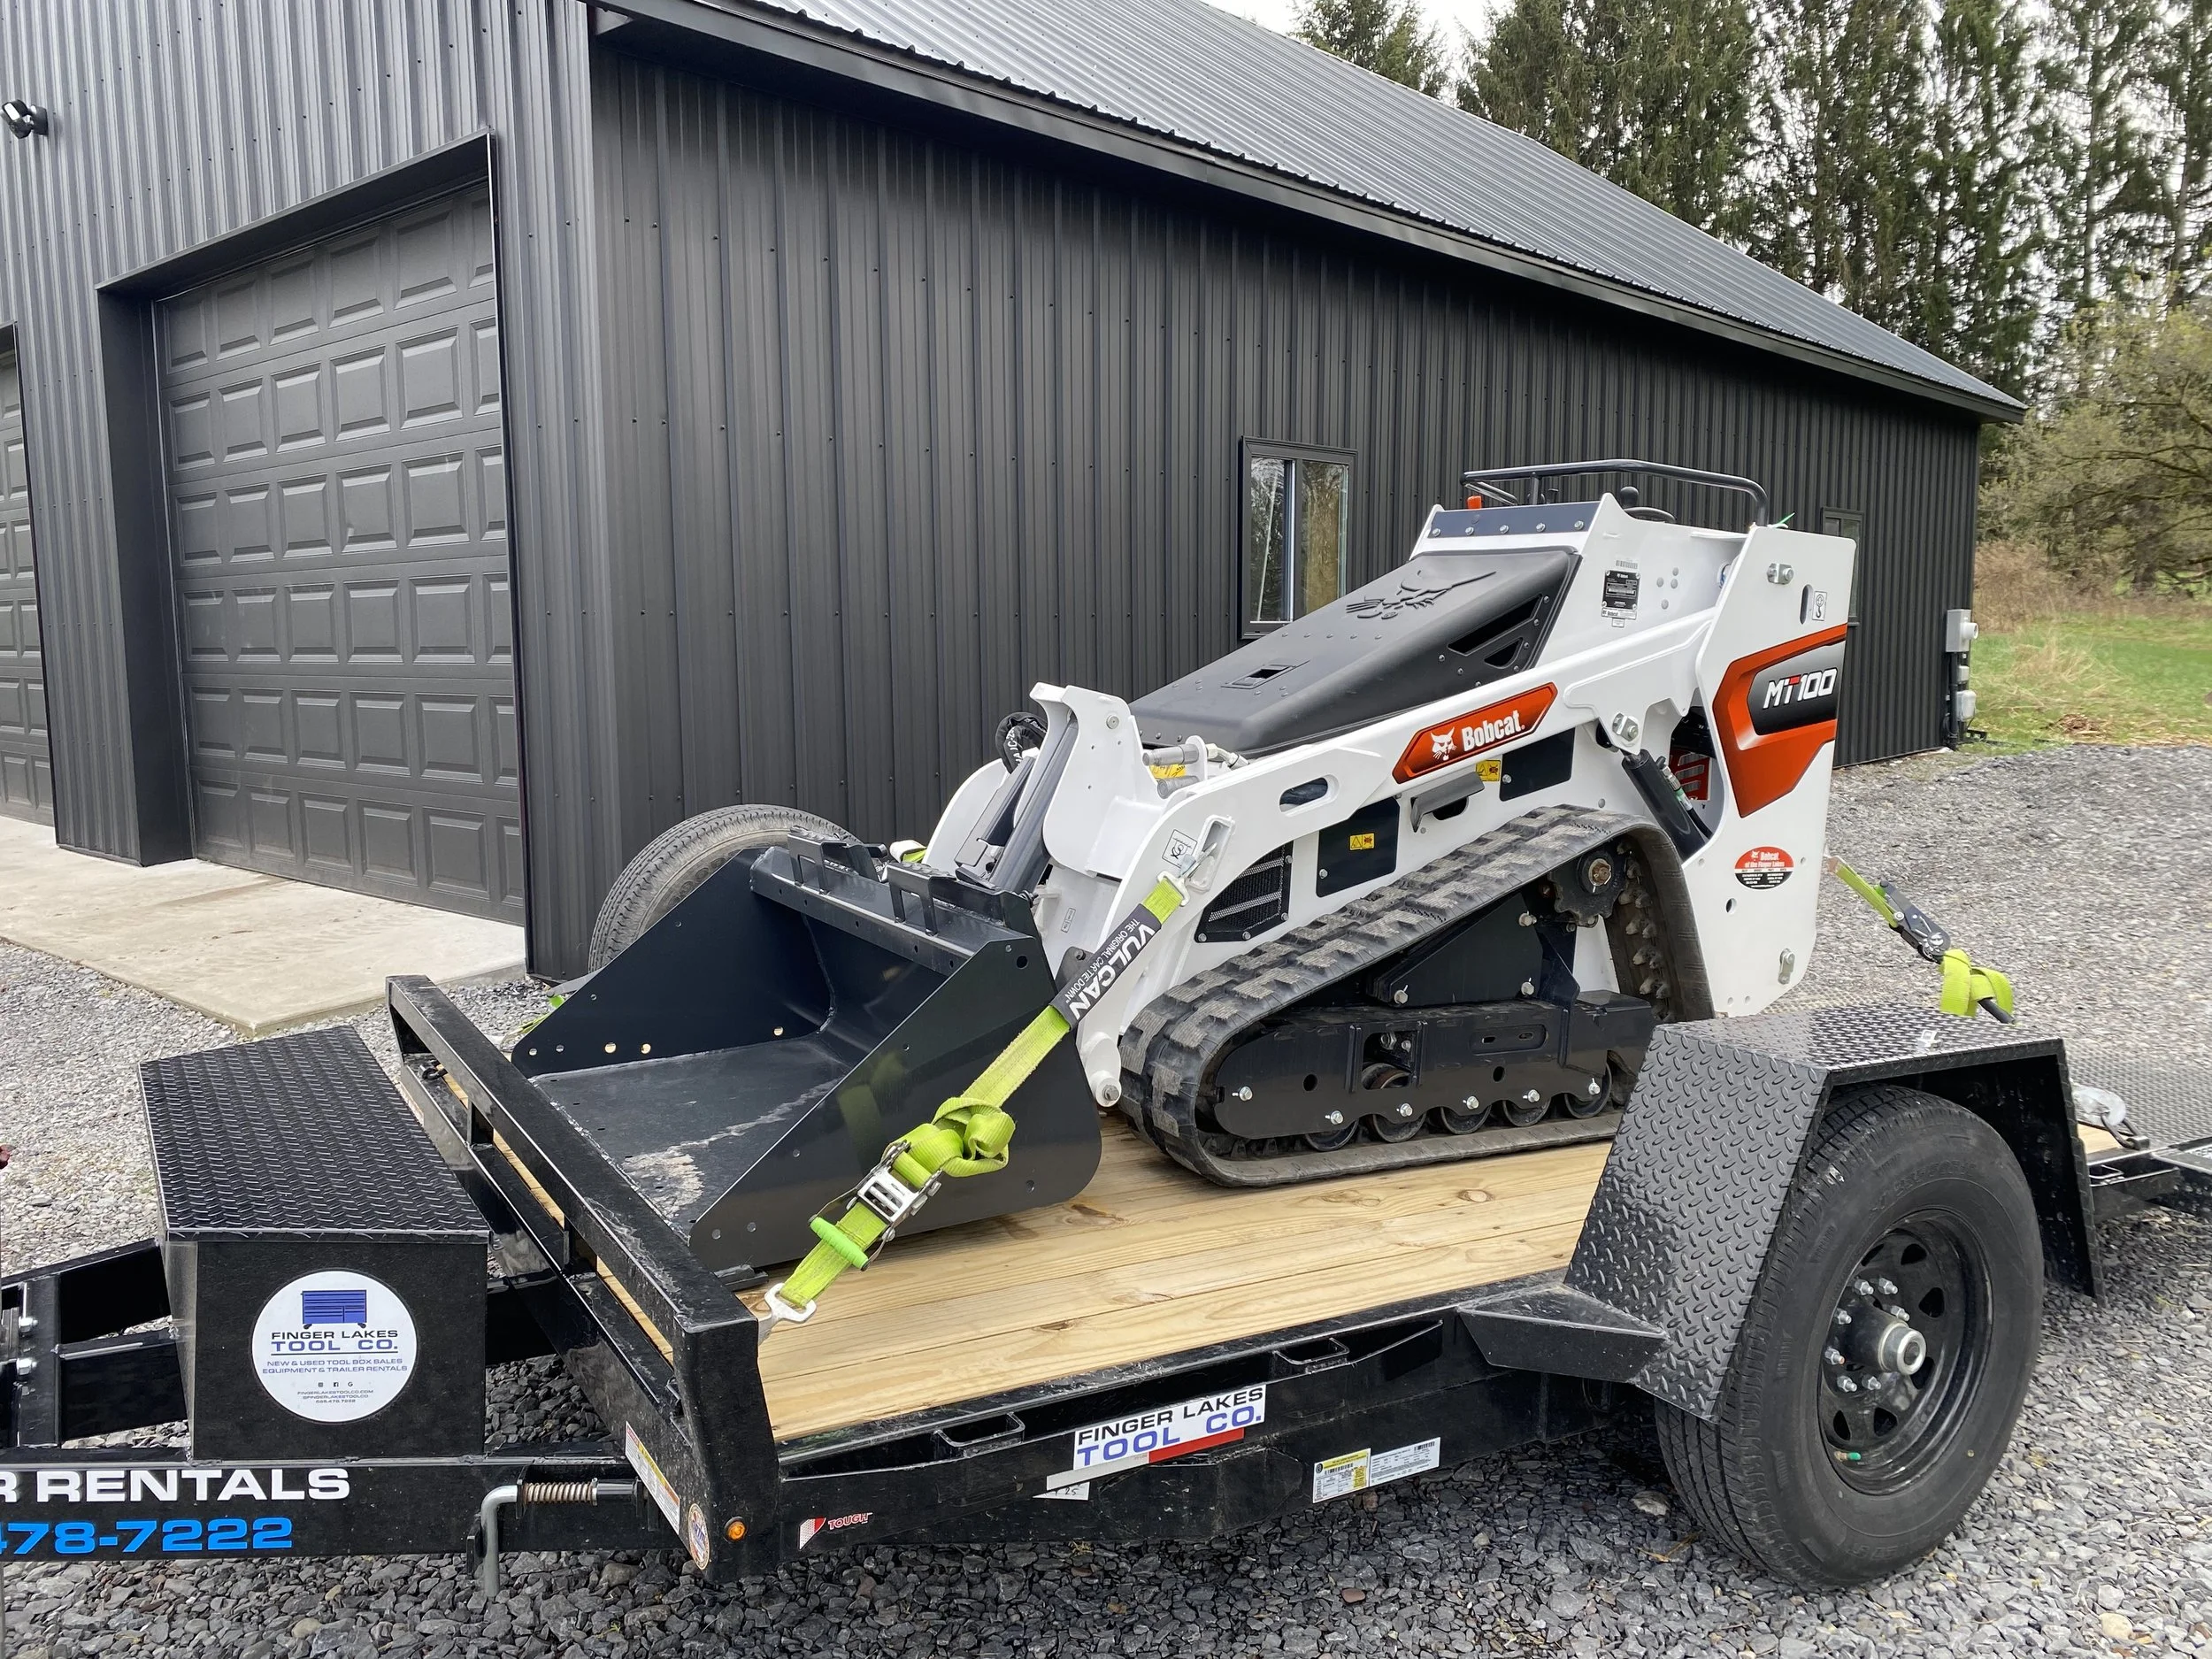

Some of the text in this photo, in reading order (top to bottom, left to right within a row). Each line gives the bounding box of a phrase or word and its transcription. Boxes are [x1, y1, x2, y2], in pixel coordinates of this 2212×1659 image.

[1763, 667, 1838, 710] MT100
[1462, 710, 1523, 752] Bobcat
[1124, 918, 1140, 933] THE
[1101, 930, 1128, 958] ORIGINAL
[1069, 924, 1156, 1020] VULCAN
[1081, 971, 1094, 982] TIE
[1089, 956, 1104, 972] CAR
[271, 1339, 398, 1352] TOOL CO.
[272, 1330, 398, 1340] FINGER LAKES
[1078, 1387, 1263, 1446] FINGER LAKES
[1077, 1405, 1262, 1466] TOOL CO.
[36, 1468, 350, 1502] RENTALS
[0, 1517, 293, 1555] 78-7222
[828, 1513, 870, 1531] TOUGH
